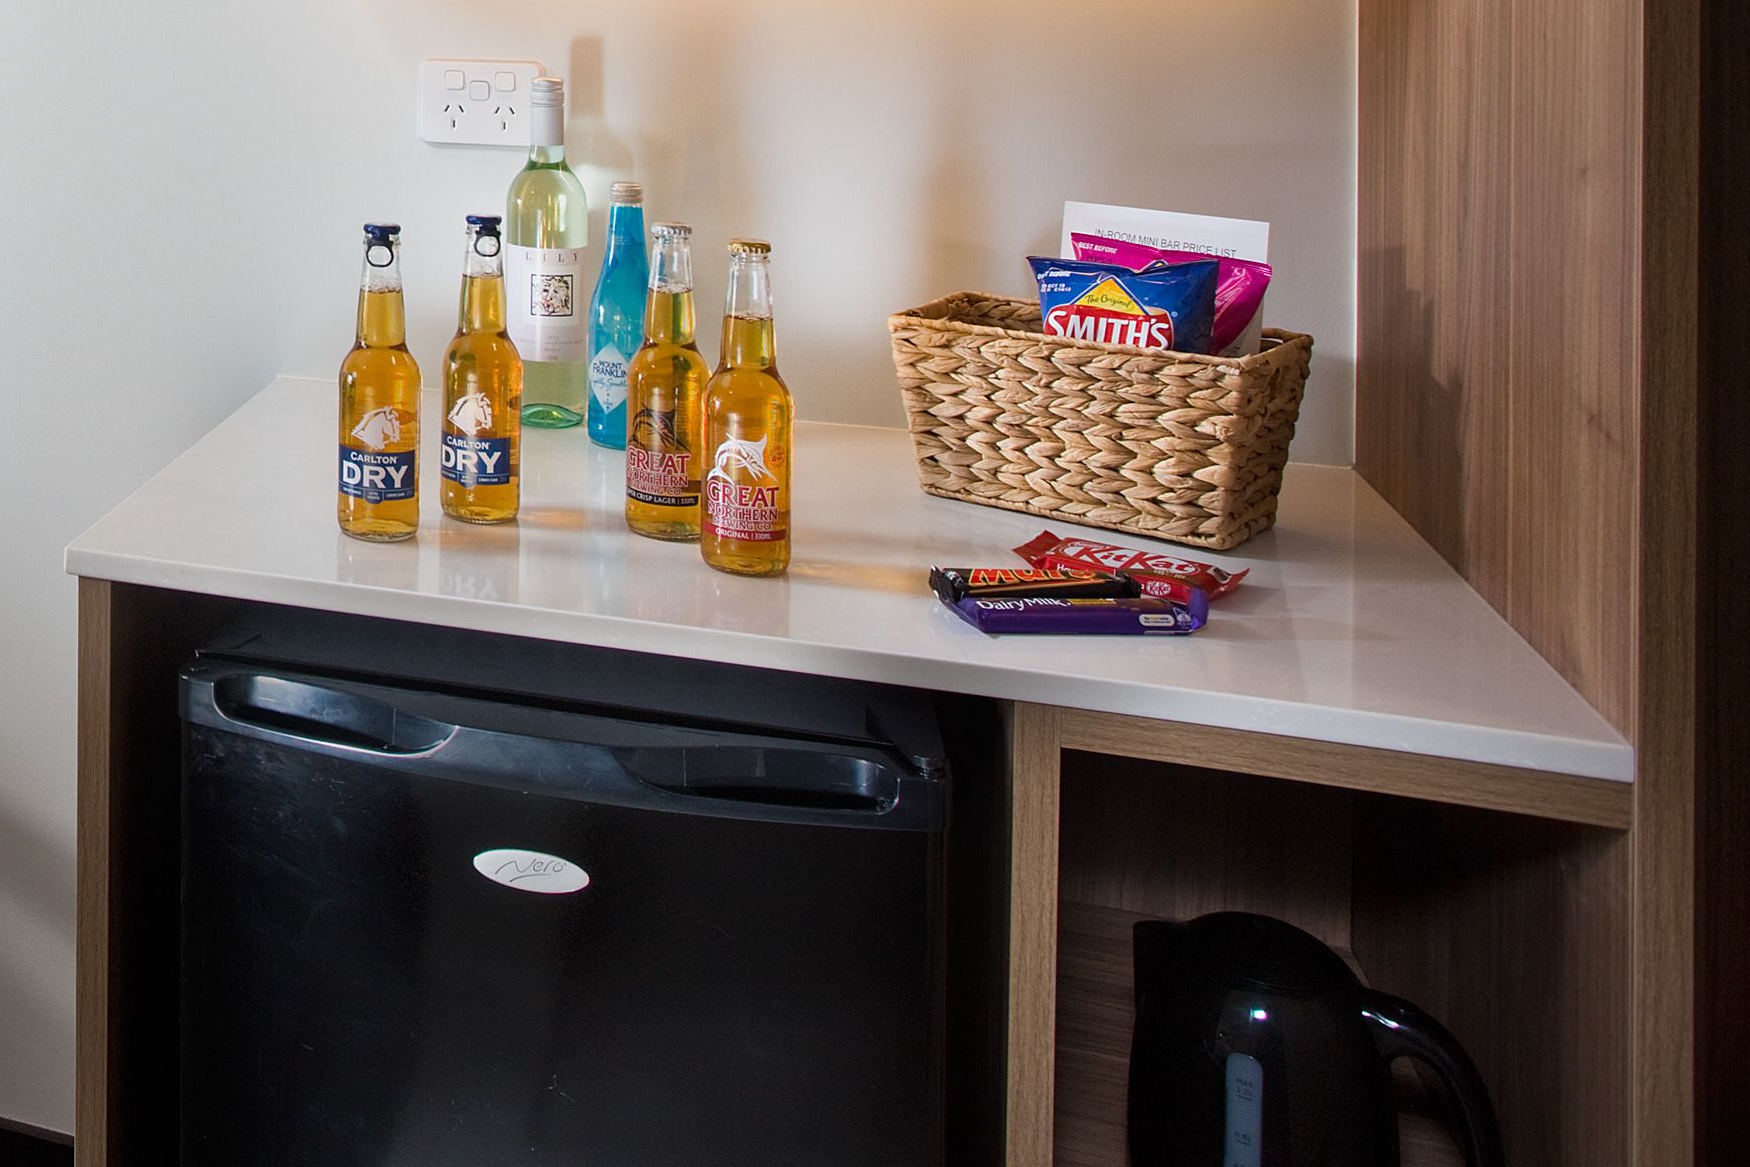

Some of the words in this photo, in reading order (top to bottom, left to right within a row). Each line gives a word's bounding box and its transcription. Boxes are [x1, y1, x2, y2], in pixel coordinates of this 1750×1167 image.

[1138, 234, 1158, 248] MINI
[1161, 238, 1180, 250] BAR
[1183, 242, 1212, 255] PRICE
[1085, 294, 1099, 304] The
[1100, 294, 1133, 308] Original
[1048, 310, 1170, 351] SMITH'S
[599, 360, 622, 370] MOUNT
[447, 436, 490, 450] CARLTON
[350, 451, 397, 464] CARLTON
[441, 444, 502, 474] DRY
[627, 445, 692, 474] GREAT
[342, 460, 409, 489] DRY
[636, 492, 653, 502] CRISP
[653, 495, 676, 504] LAGER
[707, 479, 780, 507] GREAT
[707, 500, 779, 521] NORTHERN
[715, 527, 750, 540] ORIGINAL
[975, 599, 1026, 611] Dairy
[495, 858, 565, 875] Nero
